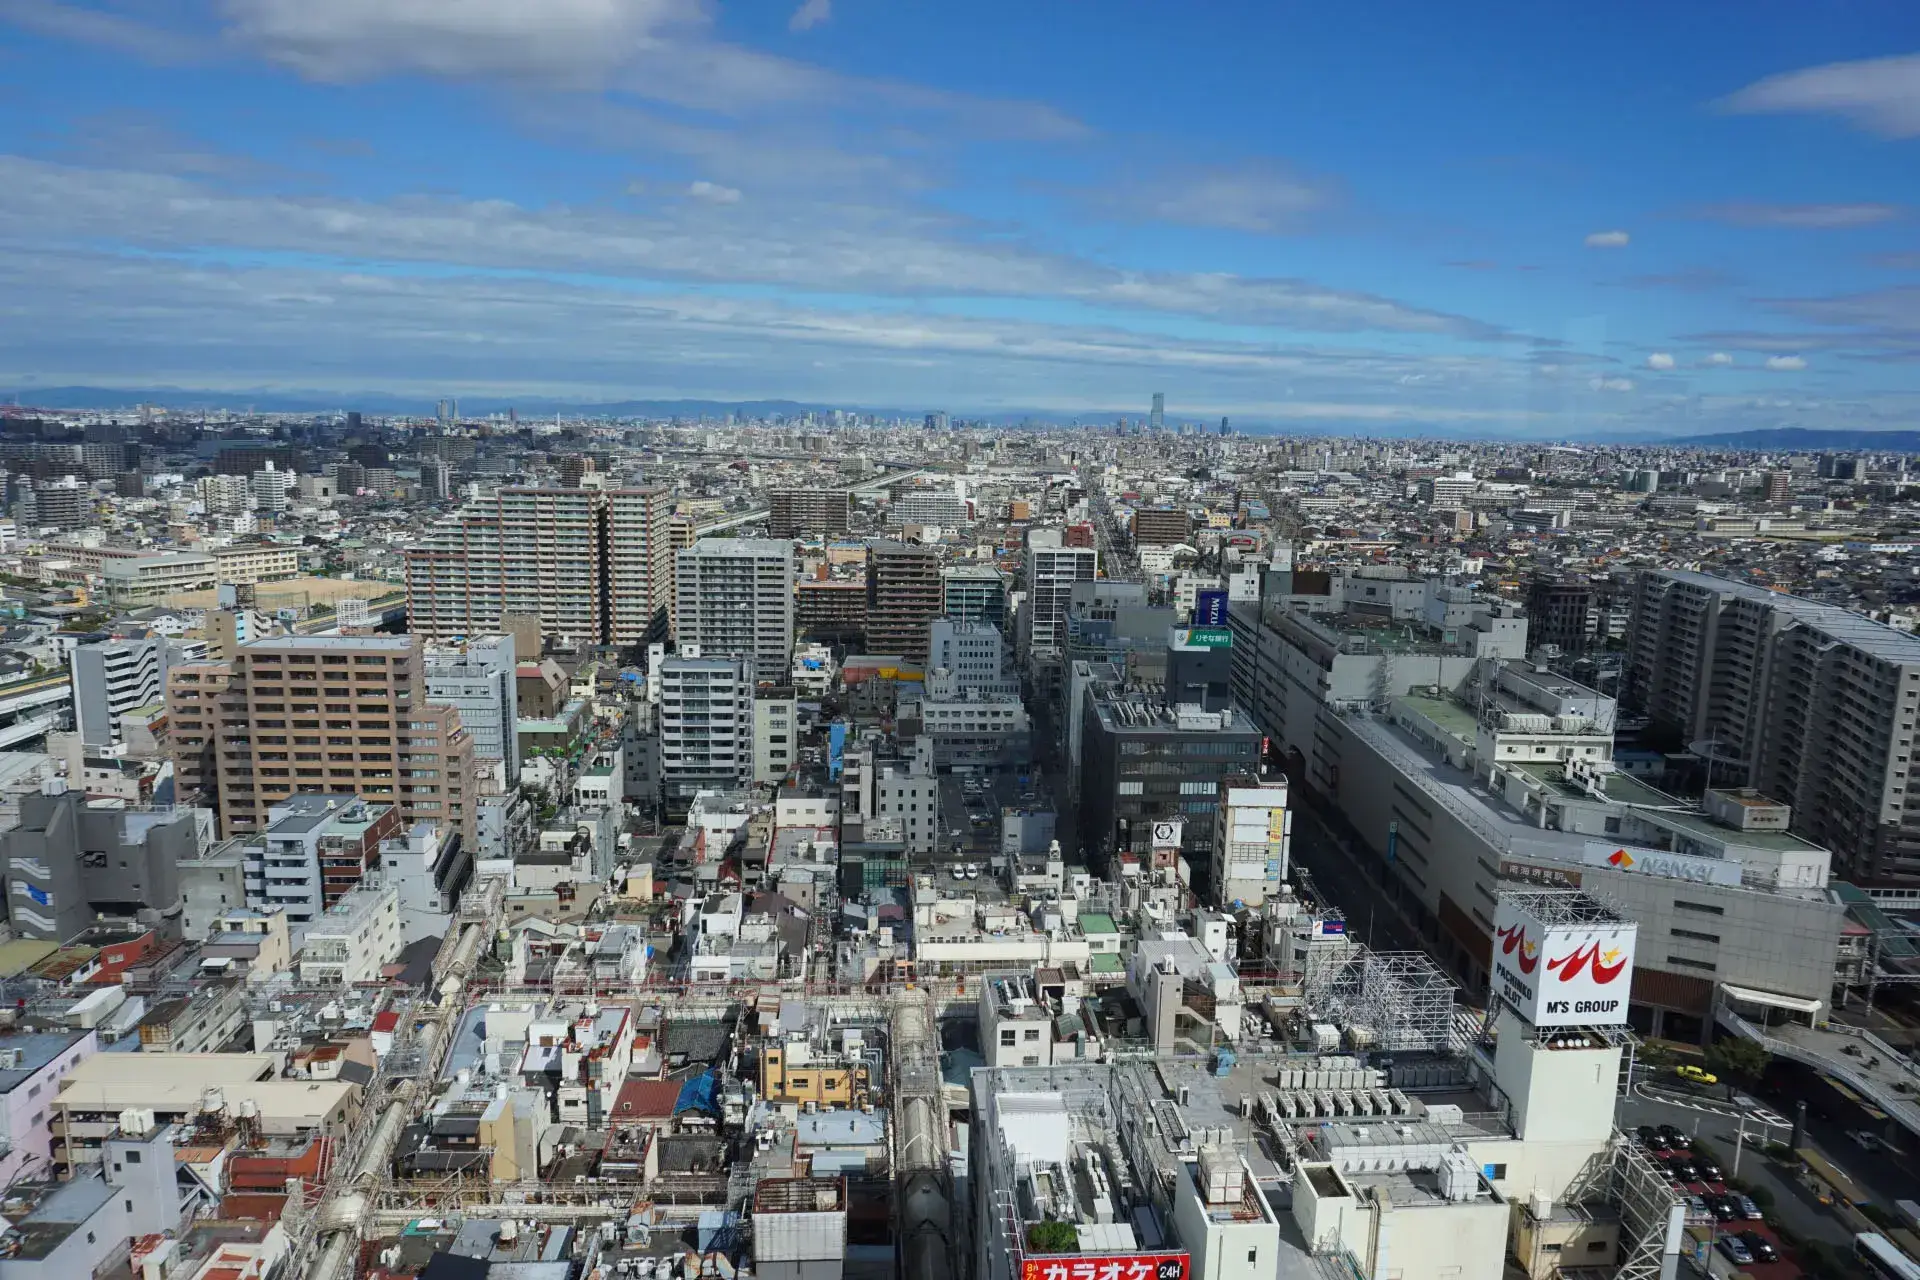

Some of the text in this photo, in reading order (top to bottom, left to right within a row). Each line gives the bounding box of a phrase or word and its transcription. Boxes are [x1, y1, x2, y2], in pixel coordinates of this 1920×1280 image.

[1210, 597, 1220, 626] MIZU
[1195, 634, 1229, 643] りそな銀行
[1640, 856, 1717, 881] NANKAI
[1496, 961, 1532, 1001] PACHINKO
[1503, 983, 1521, 1007] SLOT
[1575, 1000, 1619, 1013] GROUP
[1043, 1260, 1180, 1280] カラオケ 24H
